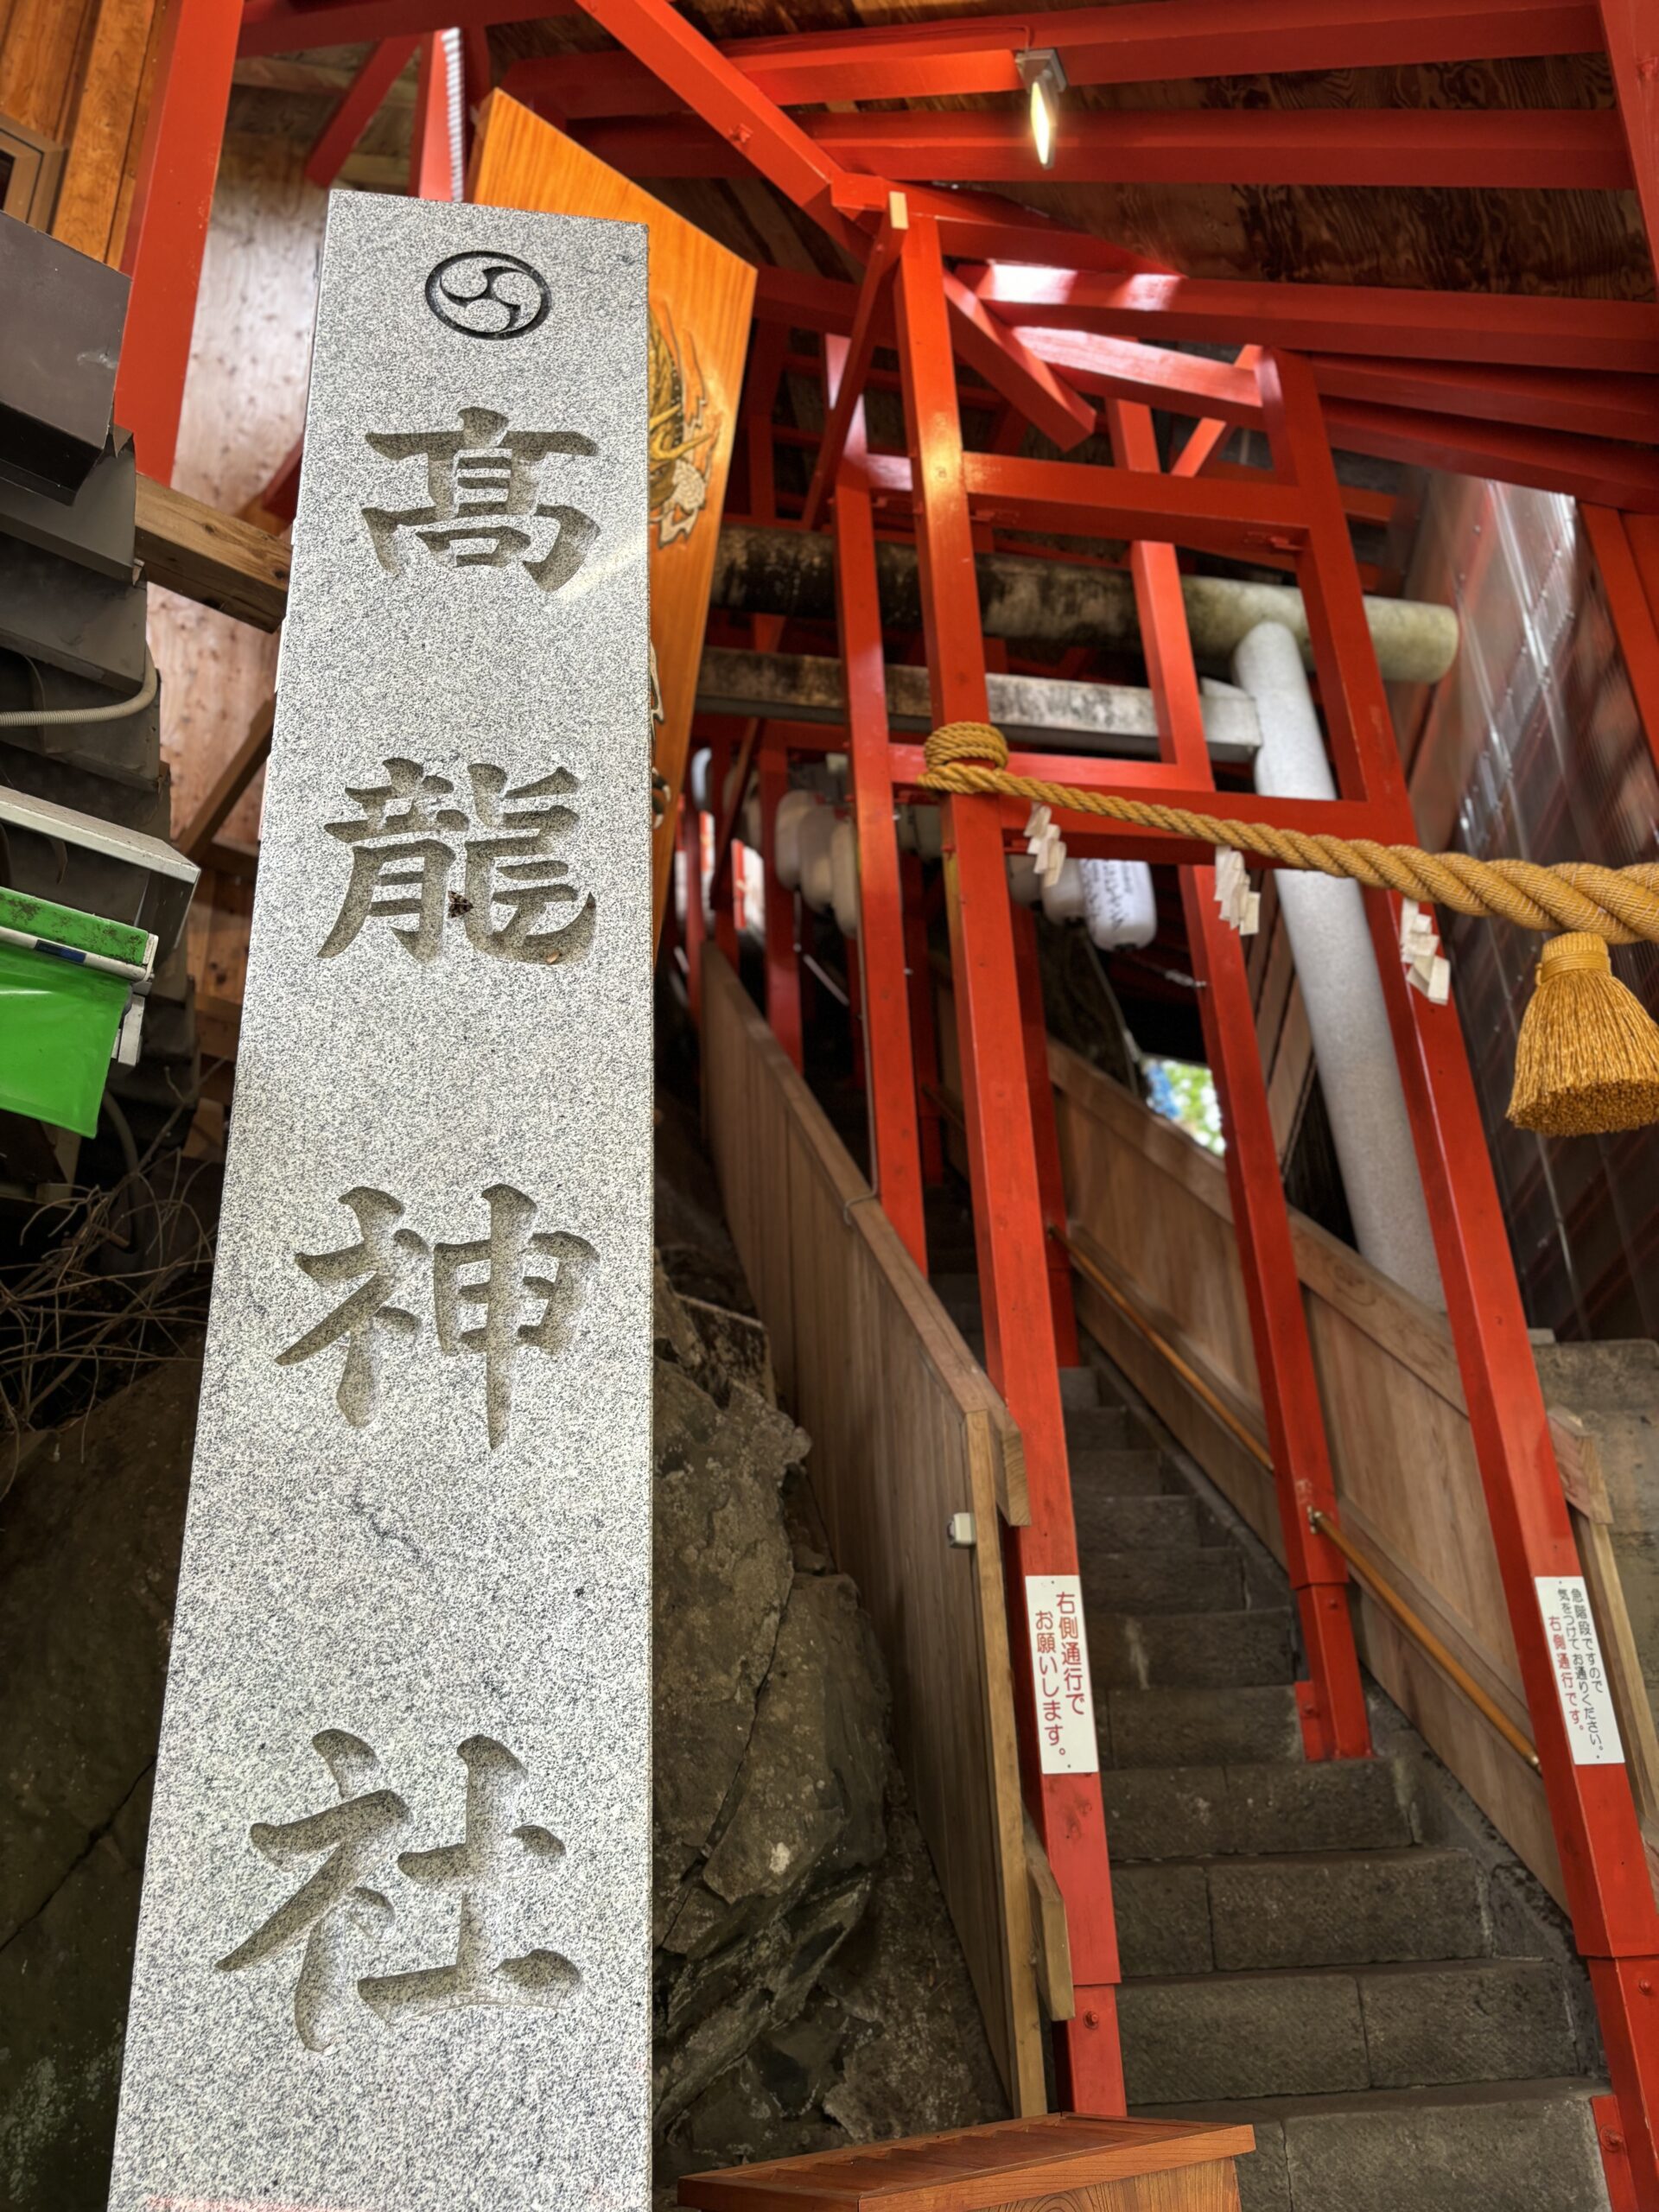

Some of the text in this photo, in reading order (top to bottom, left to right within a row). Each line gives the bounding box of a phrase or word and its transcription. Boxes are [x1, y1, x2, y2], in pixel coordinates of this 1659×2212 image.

[1035, 1610, 1066, 1756] お願いします。
[1056, 1592, 1085, 1715] 右側通行で
[1548, 1616, 1584, 1731] 右側通行です。
[1570, 1587, 1603, 1694] 急階段ですので
